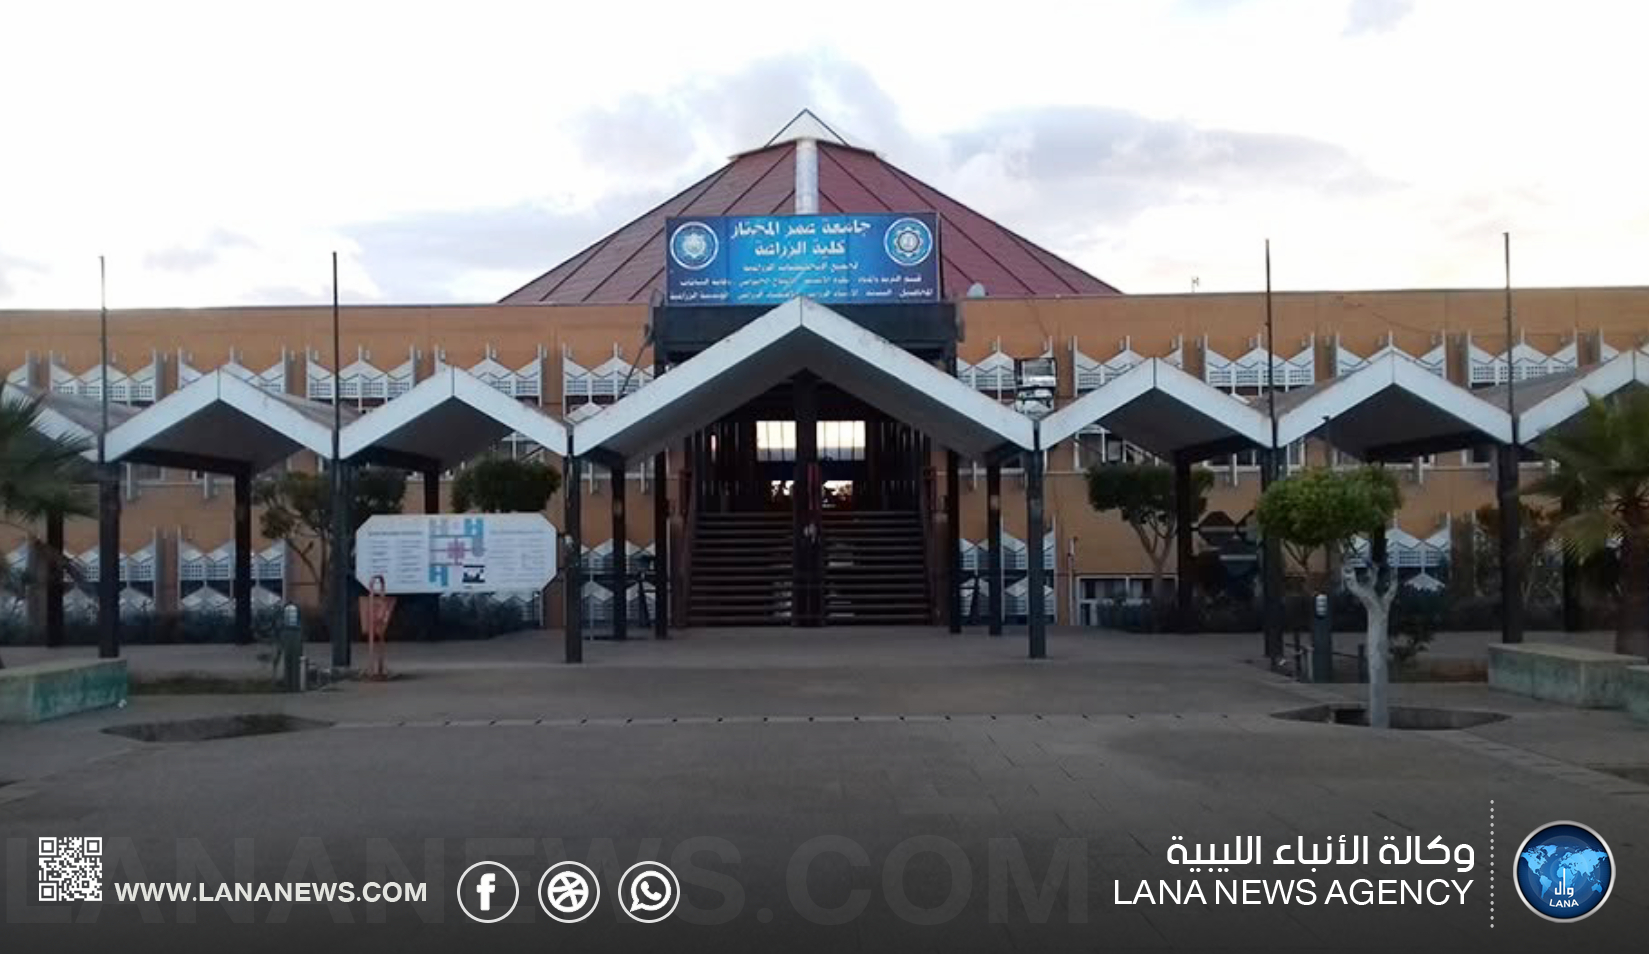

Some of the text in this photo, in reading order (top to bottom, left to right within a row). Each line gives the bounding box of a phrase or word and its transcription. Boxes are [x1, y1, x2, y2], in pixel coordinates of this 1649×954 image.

[730, 218, 872, 239] جامعة عمر المختار
[754, 238, 846, 259] كلية الزراعة
